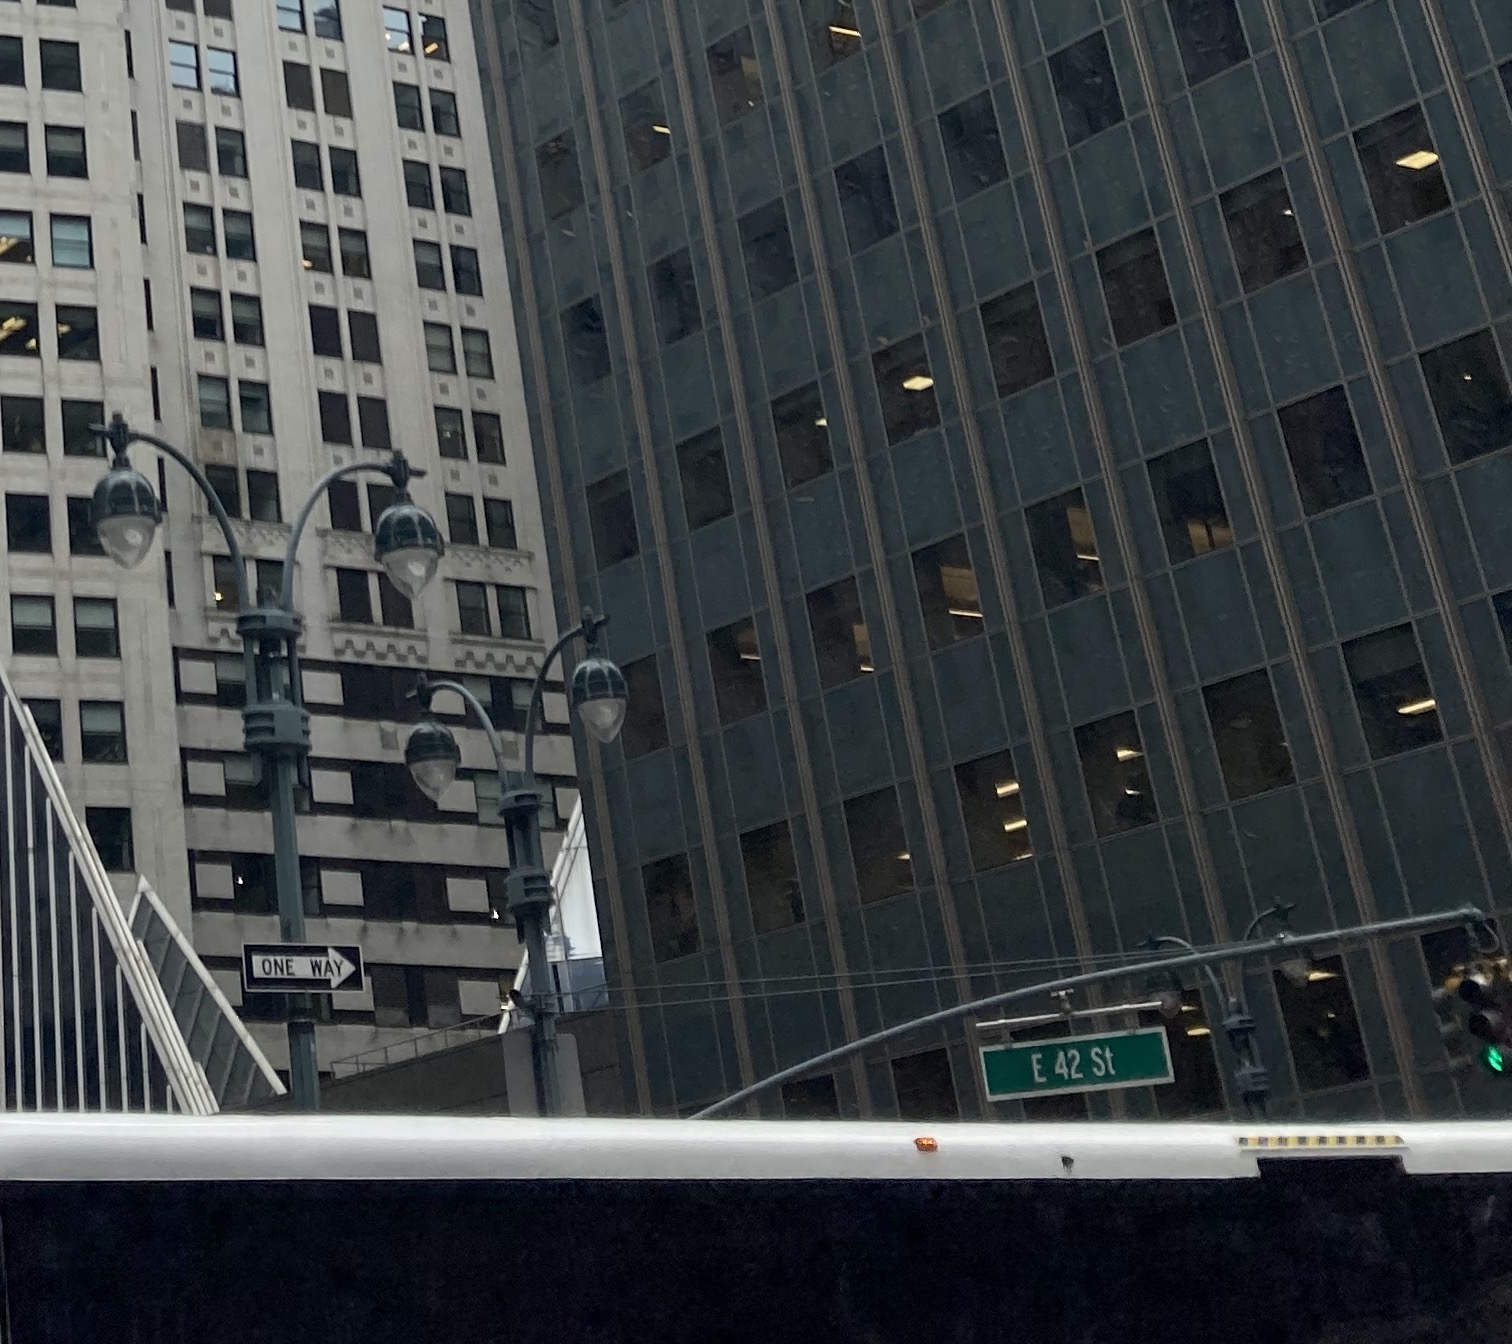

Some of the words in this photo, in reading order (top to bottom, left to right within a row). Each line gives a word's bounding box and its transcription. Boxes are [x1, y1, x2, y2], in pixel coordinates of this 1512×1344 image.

[261, 958, 295, 976] ONE
[310, 959, 343, 977] WAY
[1031, 1053, 1047, 1083] E
[1054, 1049, 1084, 1080] 42
[1090, 1045, 1116, 1077] St
